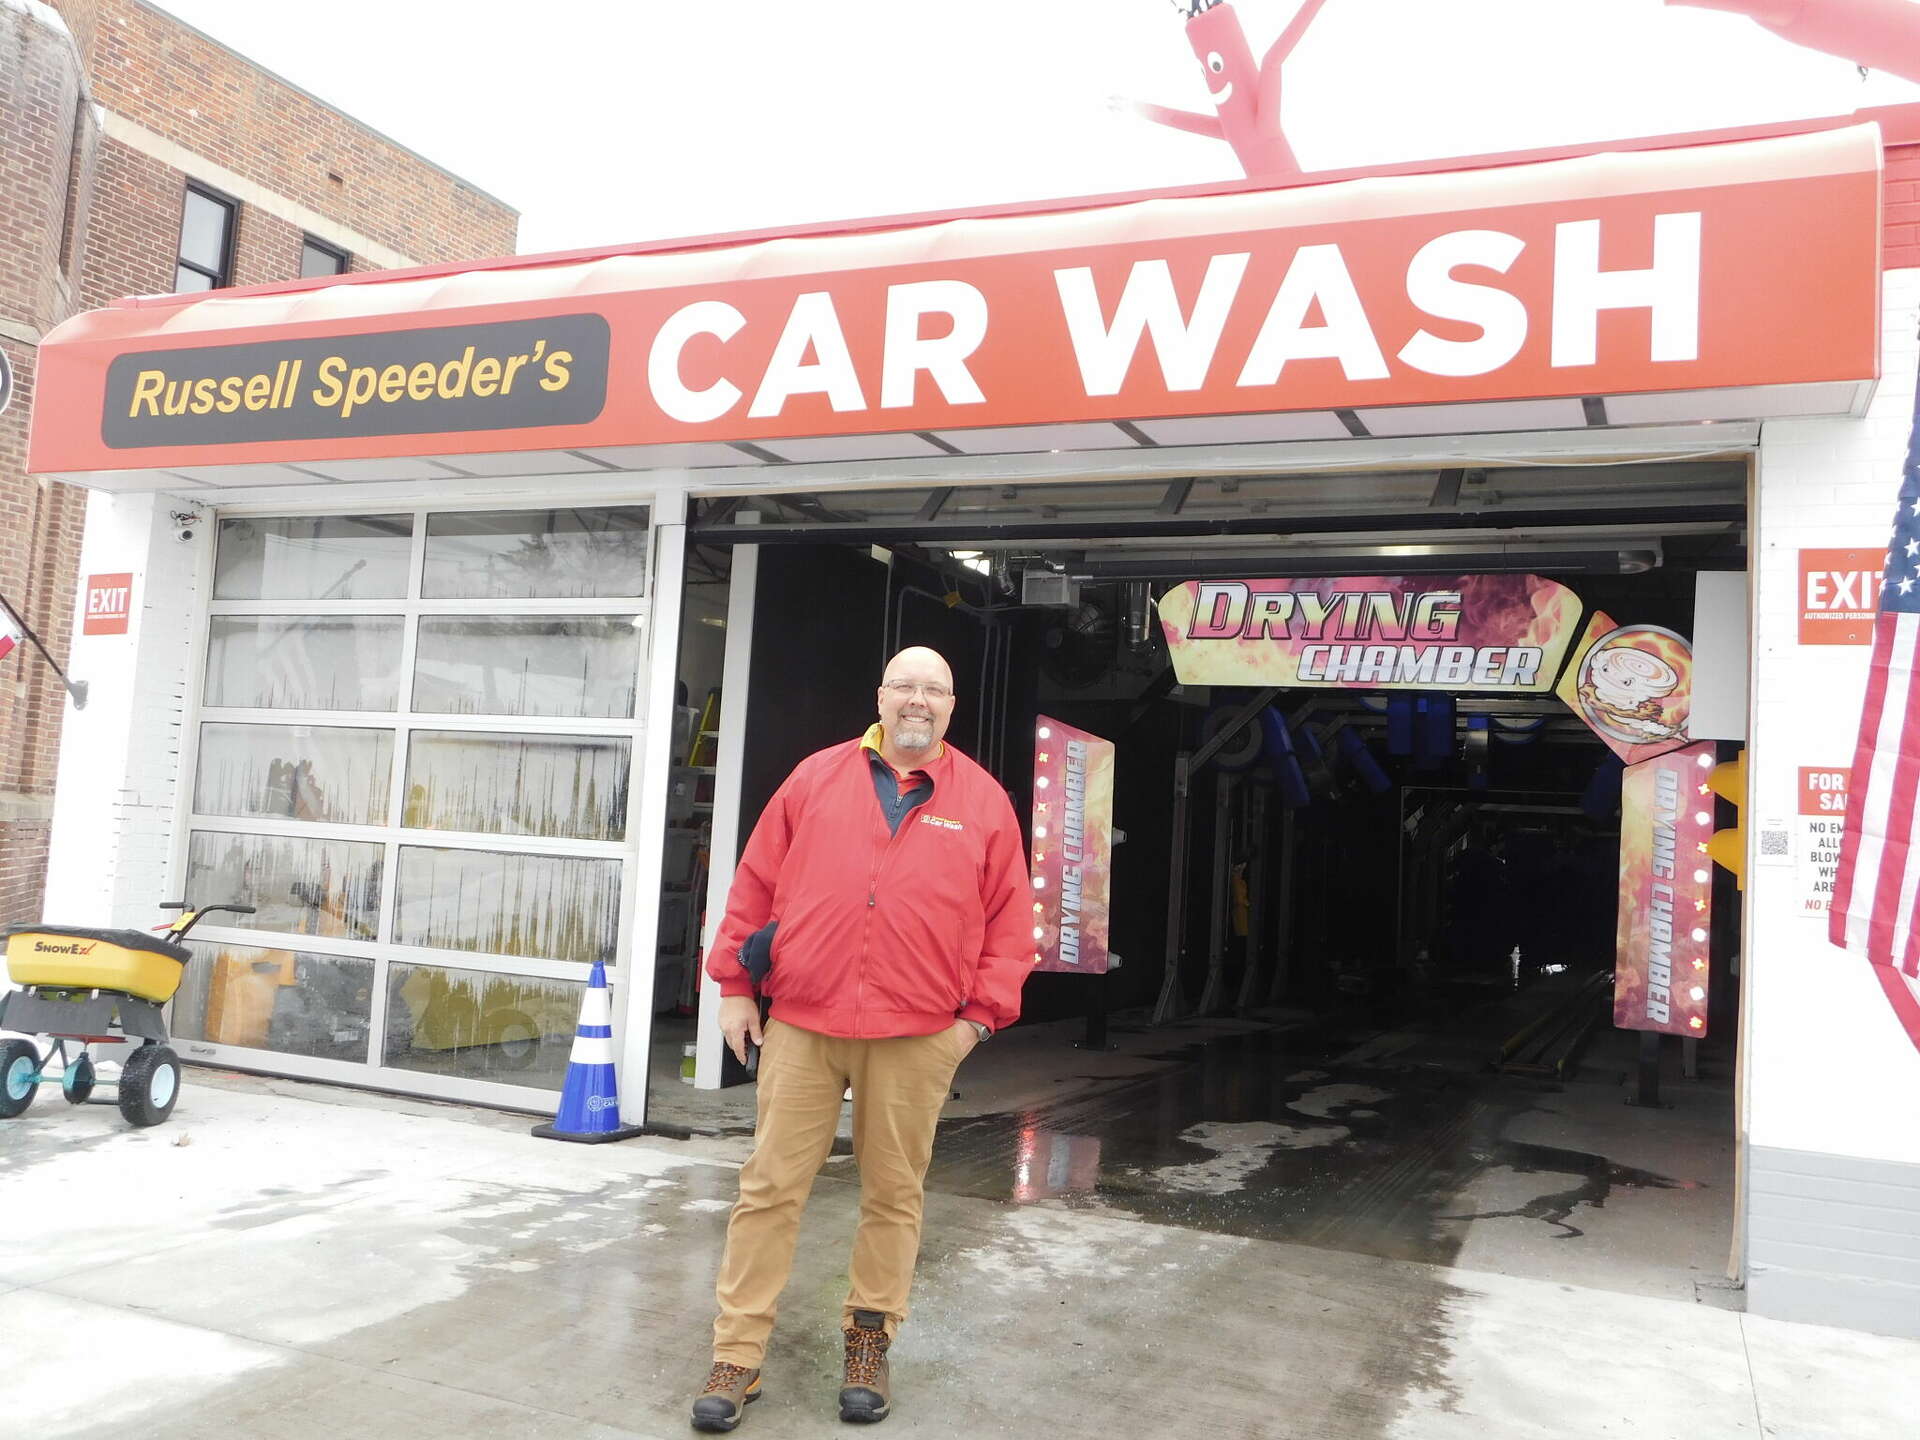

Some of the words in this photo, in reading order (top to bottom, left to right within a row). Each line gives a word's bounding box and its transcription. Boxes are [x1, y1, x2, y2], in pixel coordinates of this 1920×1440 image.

[647, 275, 989, 423] CAR
[1053, 211, 1702, 397] WASH
[128, 359, 303, 418] Russell
[88, 587, 129, 613] EXIT
[1186, 580, 1462, 642] DRYING
[1296, 643, 1543, 686] CHAMBER
[1064, 740, 1087, 862] CHAMBER
[1808, 772, 1844, 791] FOR
[1819, 792, 1848, 811] SA
[1652, 768, 1678, 880] DRYING
[1809, 822, 1826, 833] NO
[1059, 864, 1082, 965] DRYING
[1646, 883, 1674, 1025] CHAMBER
